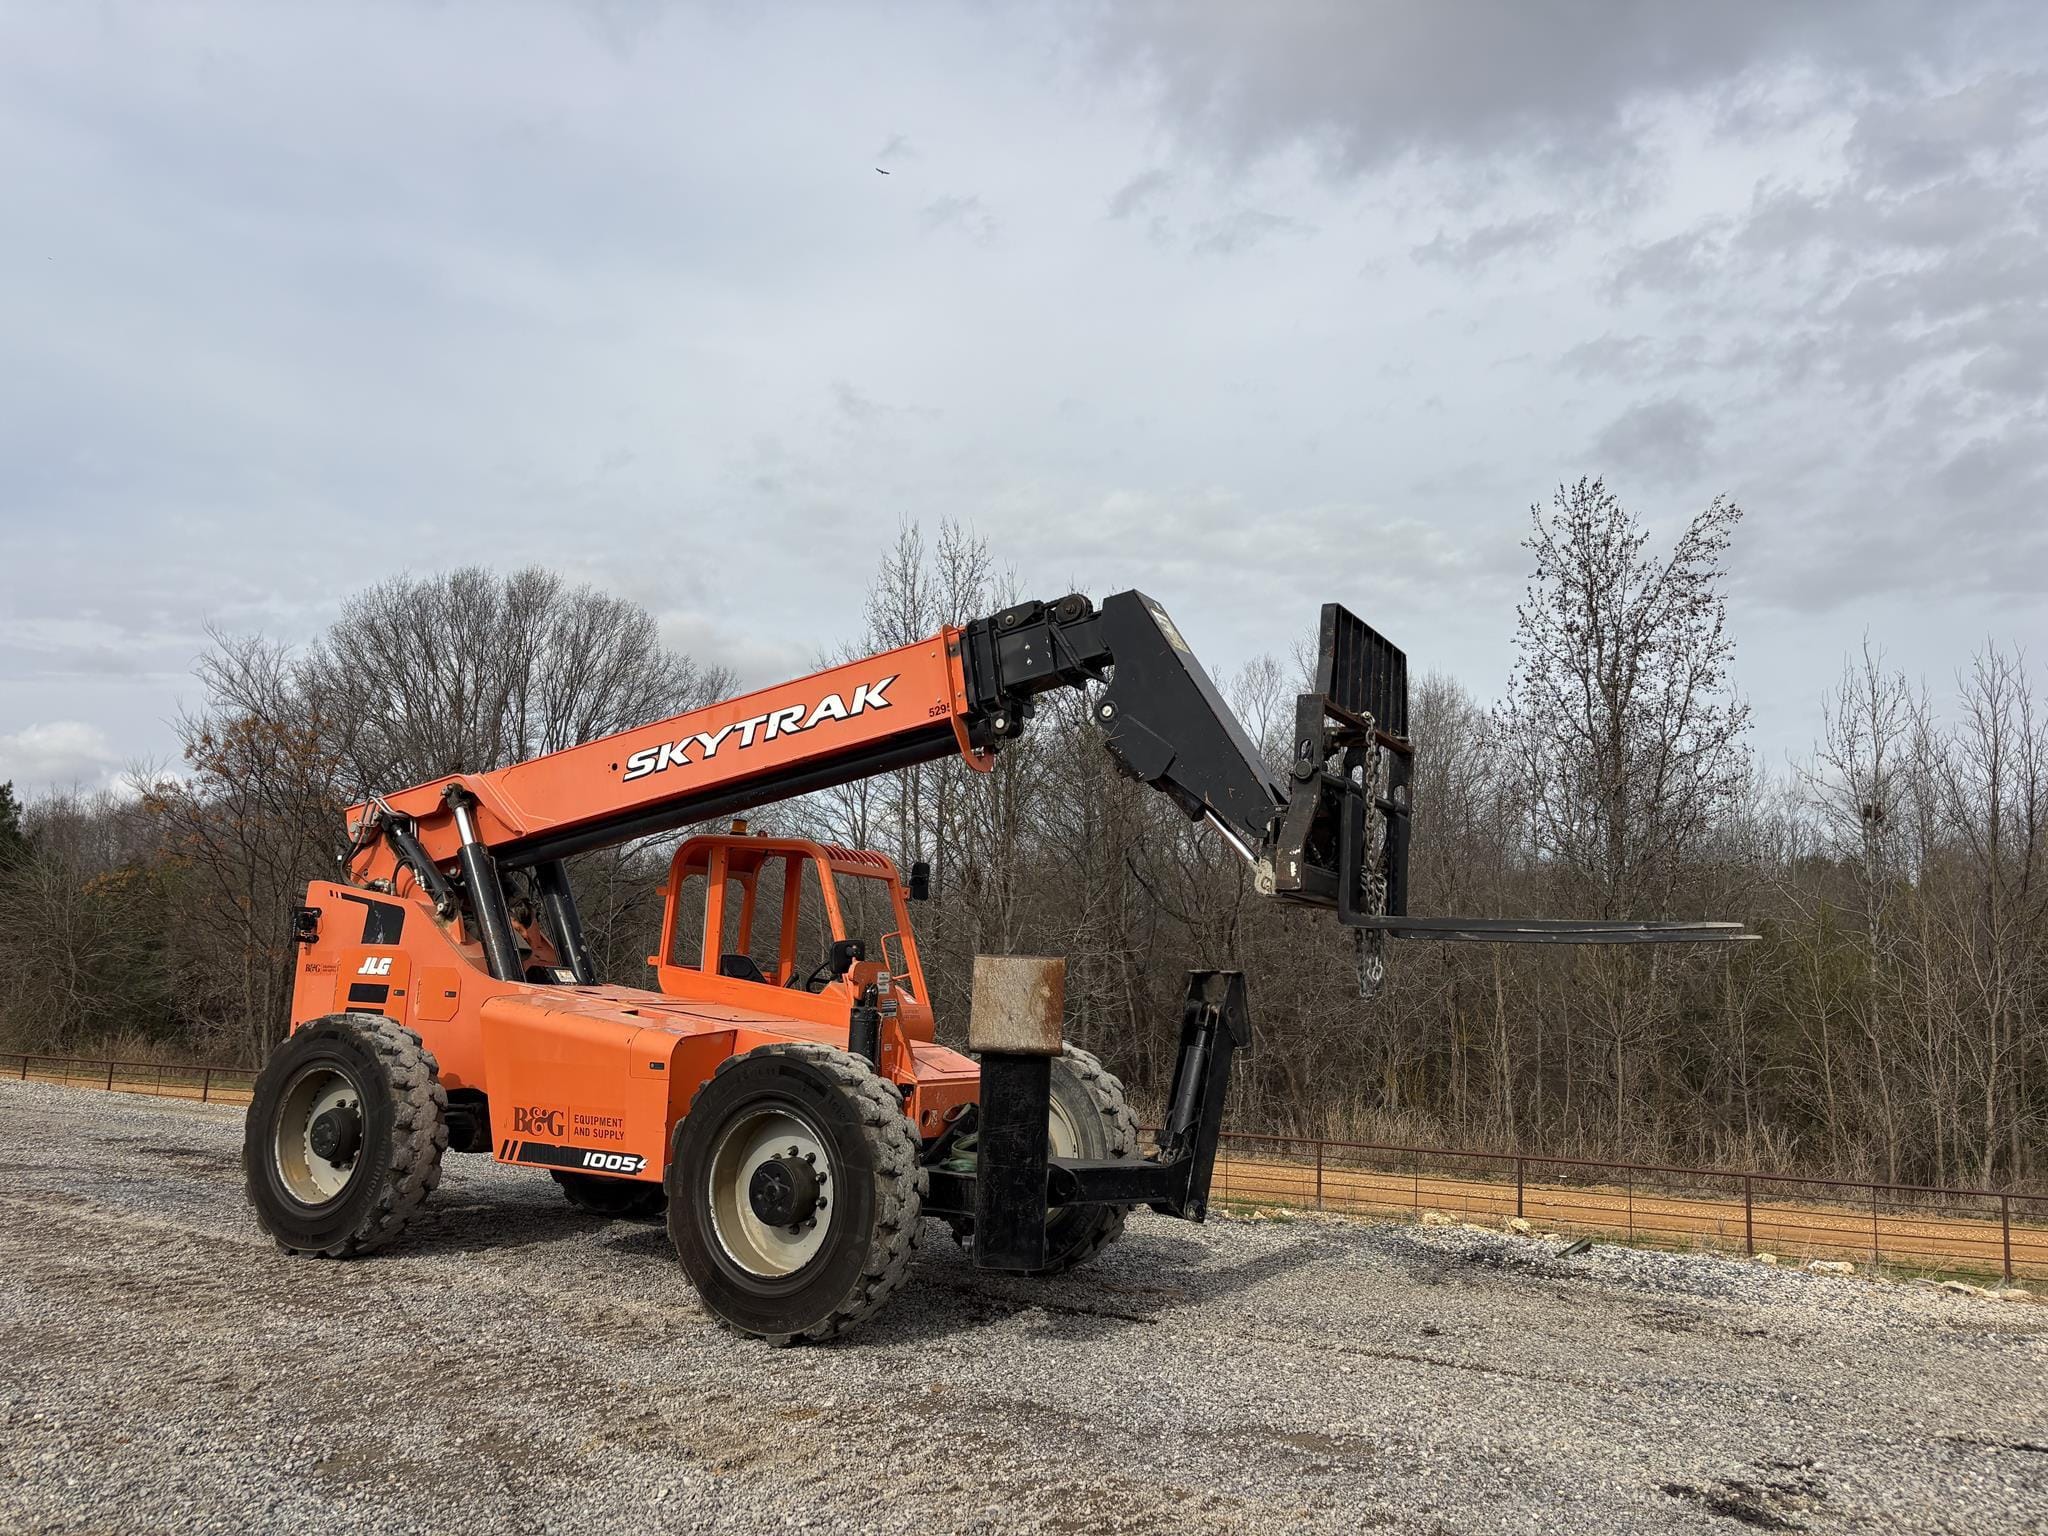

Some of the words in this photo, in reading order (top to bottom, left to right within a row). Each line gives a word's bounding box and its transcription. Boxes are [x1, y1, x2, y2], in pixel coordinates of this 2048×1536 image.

[622, 673, 901, 782] SKYTRAK
[357, 956, 393, 976] JLG
[513, 1106, 565, 1137] B&G
[574, 1114, 623, 1129] EQUIPMENT
[574, 1126, 590, 1138] AND
[593, 1128, 624, 1141] SUPPLY
